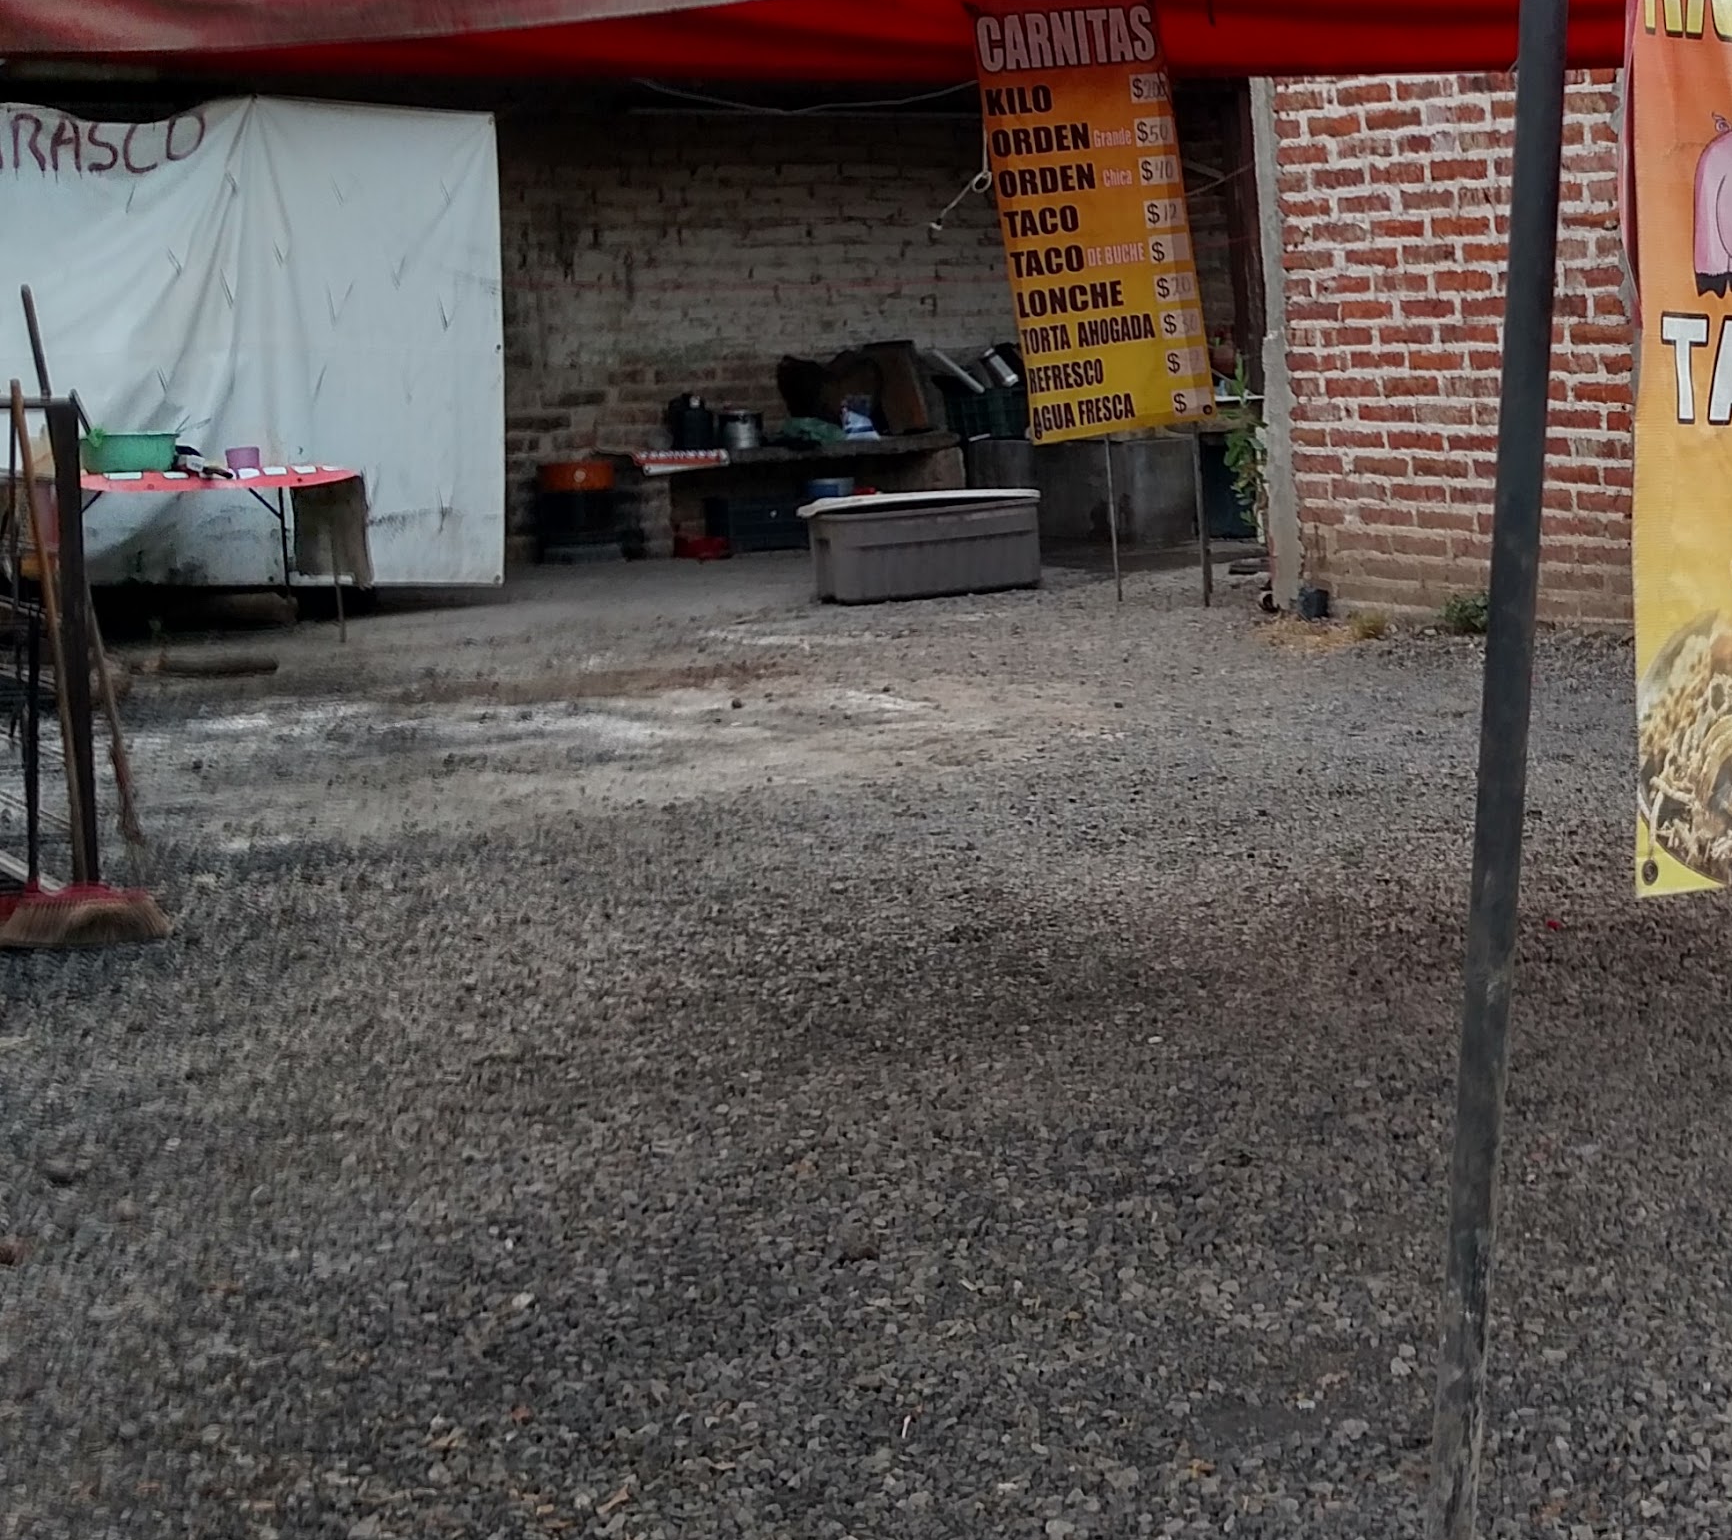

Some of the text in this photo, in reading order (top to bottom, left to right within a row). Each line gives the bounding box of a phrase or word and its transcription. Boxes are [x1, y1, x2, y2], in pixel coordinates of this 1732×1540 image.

[976, 5, 1156, 72] CARNITAS
[985, 85, 1053, 116] KILO
[0, 113, 206, 174] RASCO
[991, 121, 1168, 158] ORDEN Grande $50
[998, 162, 1096, 198] ORDEN
[1102, 168, 1133, 187] Chica
[1003, 204, 1079, 238] TACO
[1010, 244, 1085, 278] TACO
[1087, 248, 1102, 266] DE
[1104, 242, 1145, 264] BUCHE
[1016, 280, 1124, 318] LONCHE
[1021, 324, 1071, 355] TORTA
[1077, 313, 1156, 347] AHOGADA
[1027, 358, 1104, 394] REFRESCO
[1033, 402, 1076, 431] AGUA
[1077, 393, 1136, 426] FRESCA
